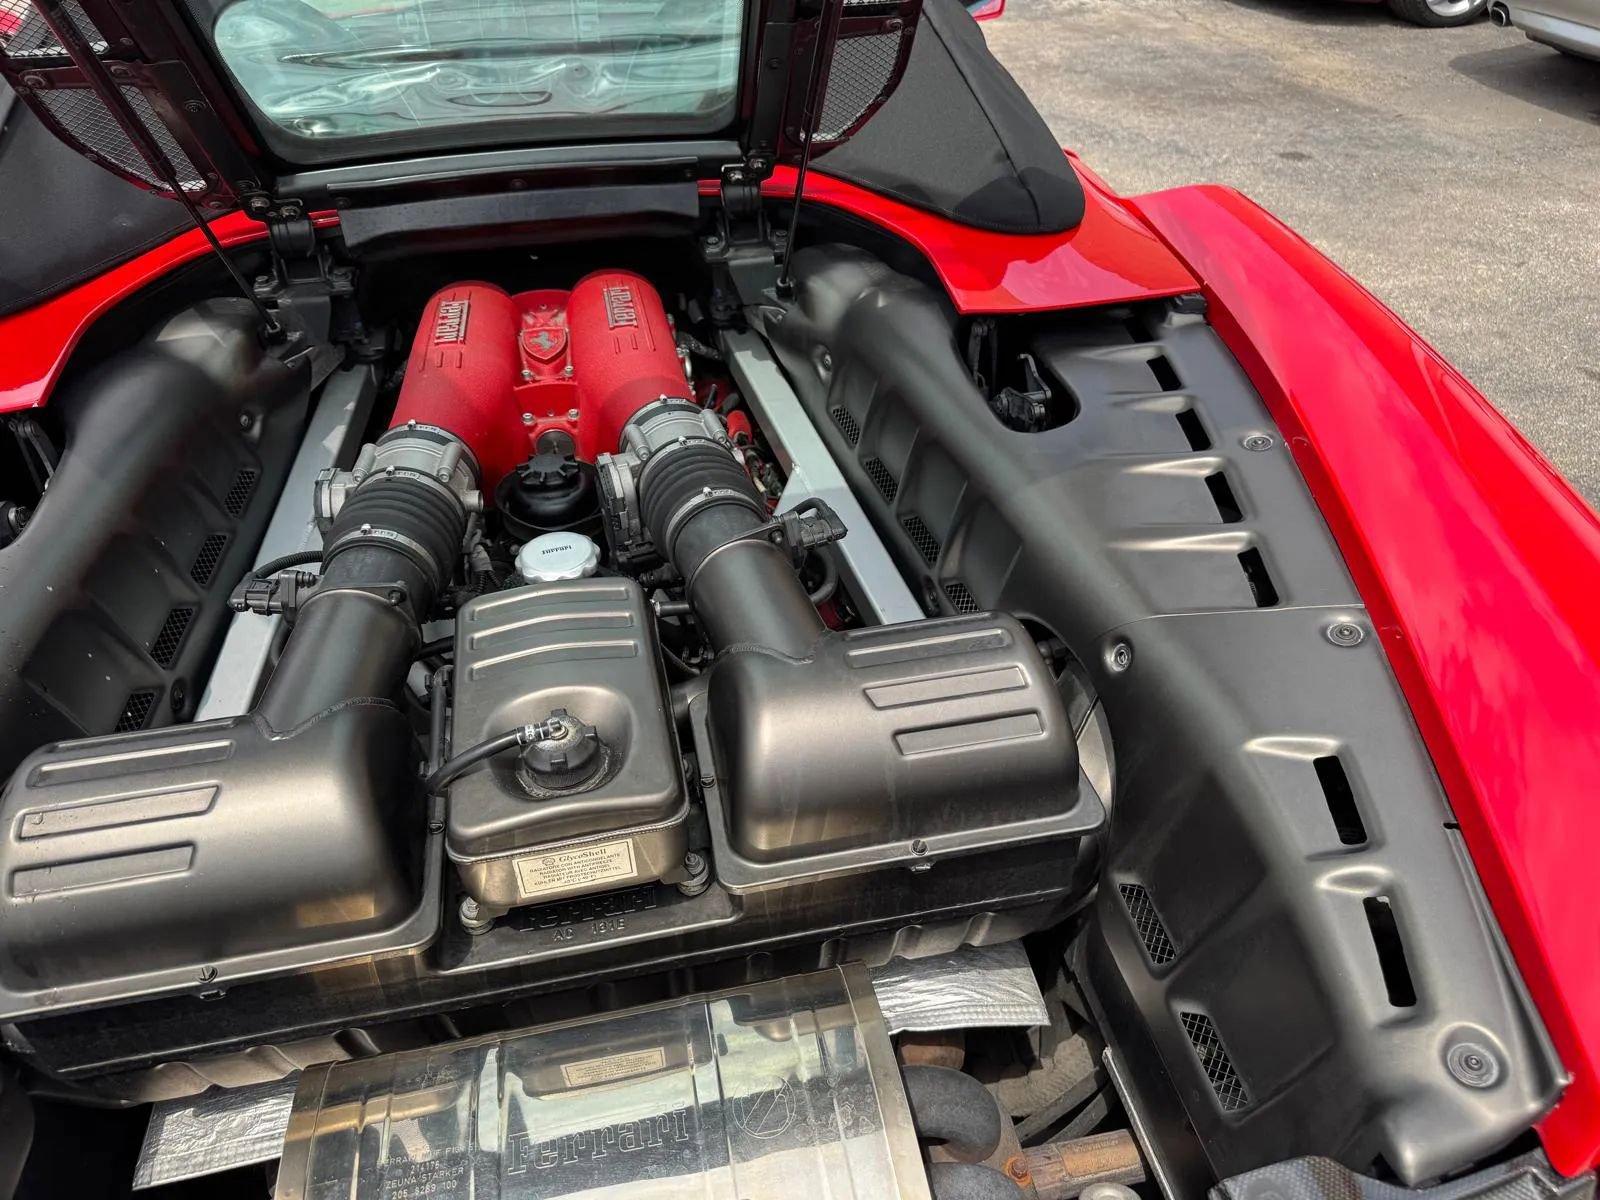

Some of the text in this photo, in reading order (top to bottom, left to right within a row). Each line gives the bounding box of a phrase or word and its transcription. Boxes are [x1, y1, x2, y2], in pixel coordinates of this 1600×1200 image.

[434, 300, 469, 343] Ferrari
[602, 286, 638, 328] Ferrari
[558, 848, 607, 863] GlycoShell
[508, 1102, 689, 1175] Ferrari
